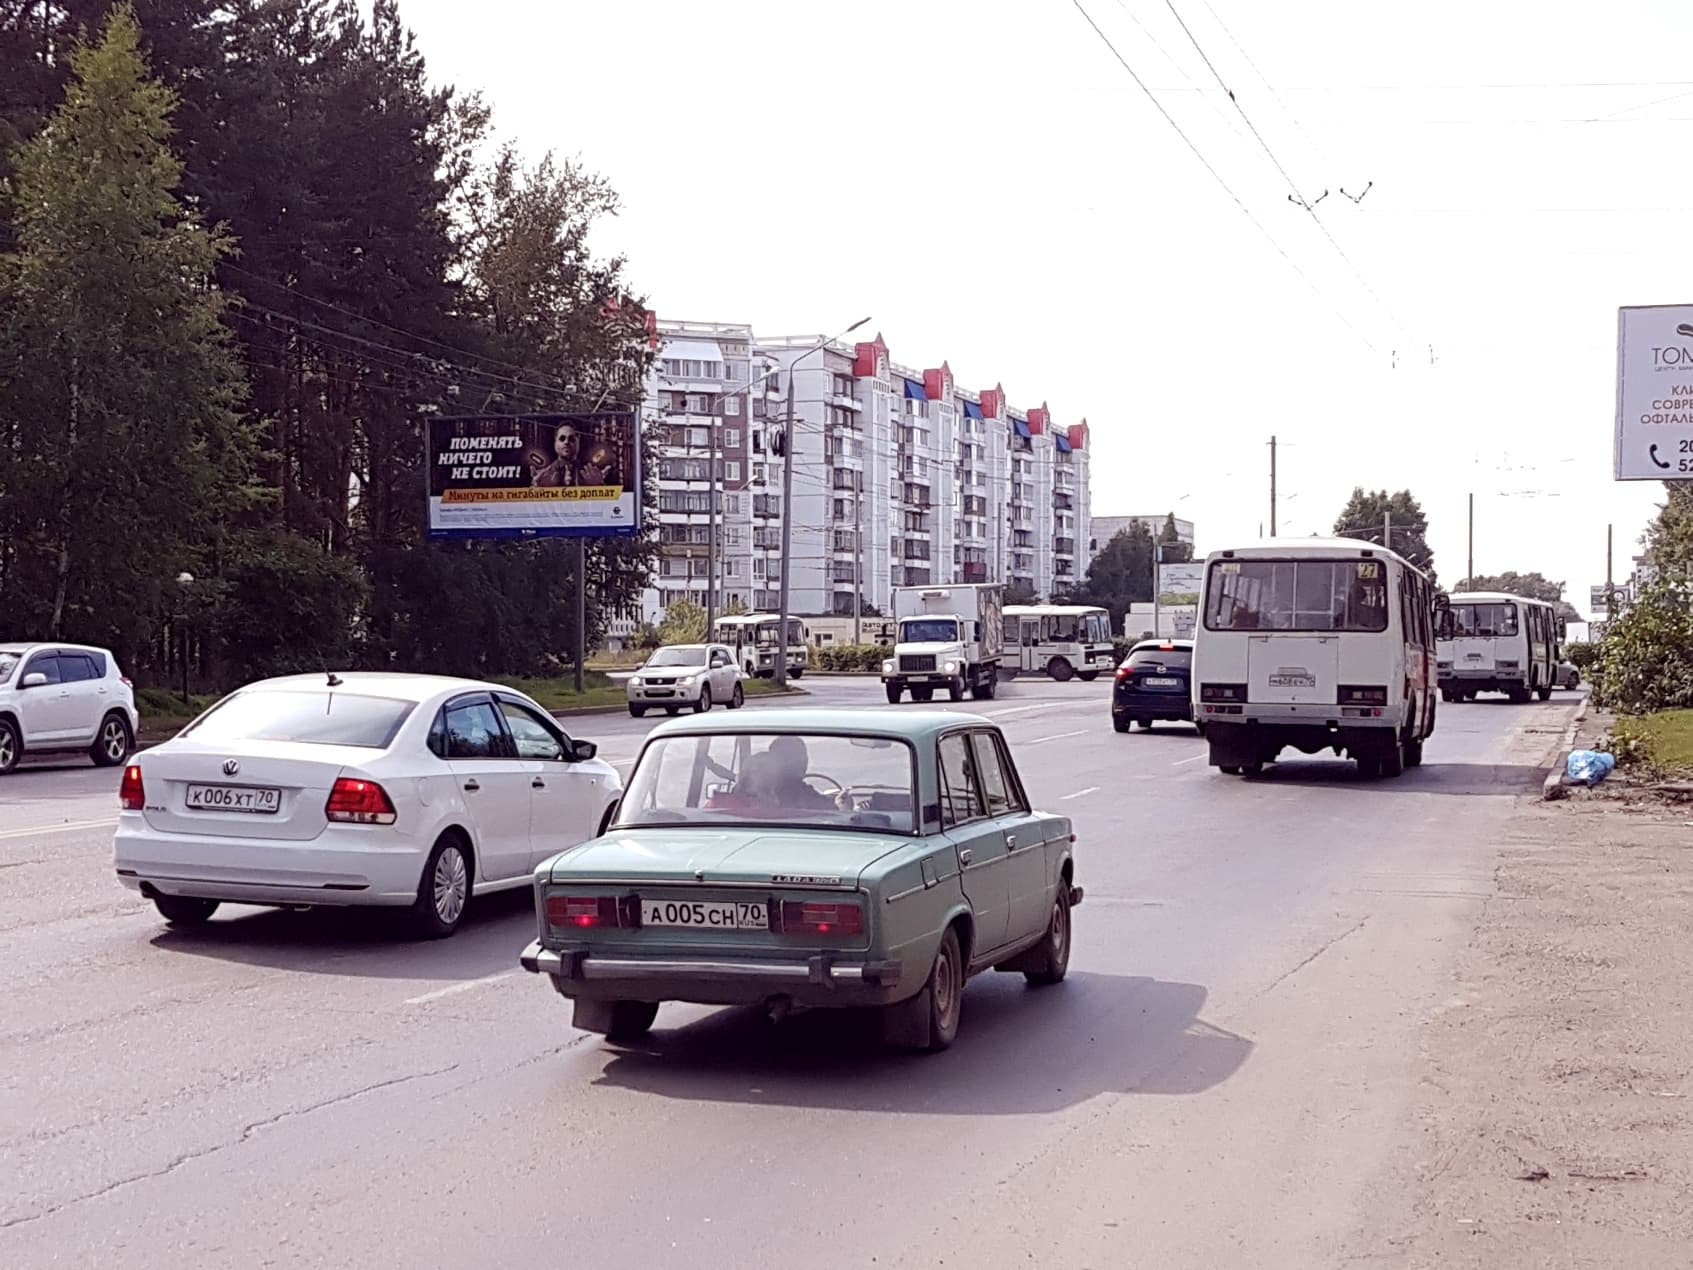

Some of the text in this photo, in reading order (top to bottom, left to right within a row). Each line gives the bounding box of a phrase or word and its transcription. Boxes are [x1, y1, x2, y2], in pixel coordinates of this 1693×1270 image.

[450, 436, 523, 450] ПОМЕНЯТЬ
[438, 452, 493, 465] НИЧЕГО
[451, 466, 522, 479] НЕ СТОИТ!
[449, 488, 615, 502] Минуты на гигабайты без доплат
[1360, 563, 1376, 577] 27
[259, 790, 274, 804] 70
[739, 904, 761, 920] 70
